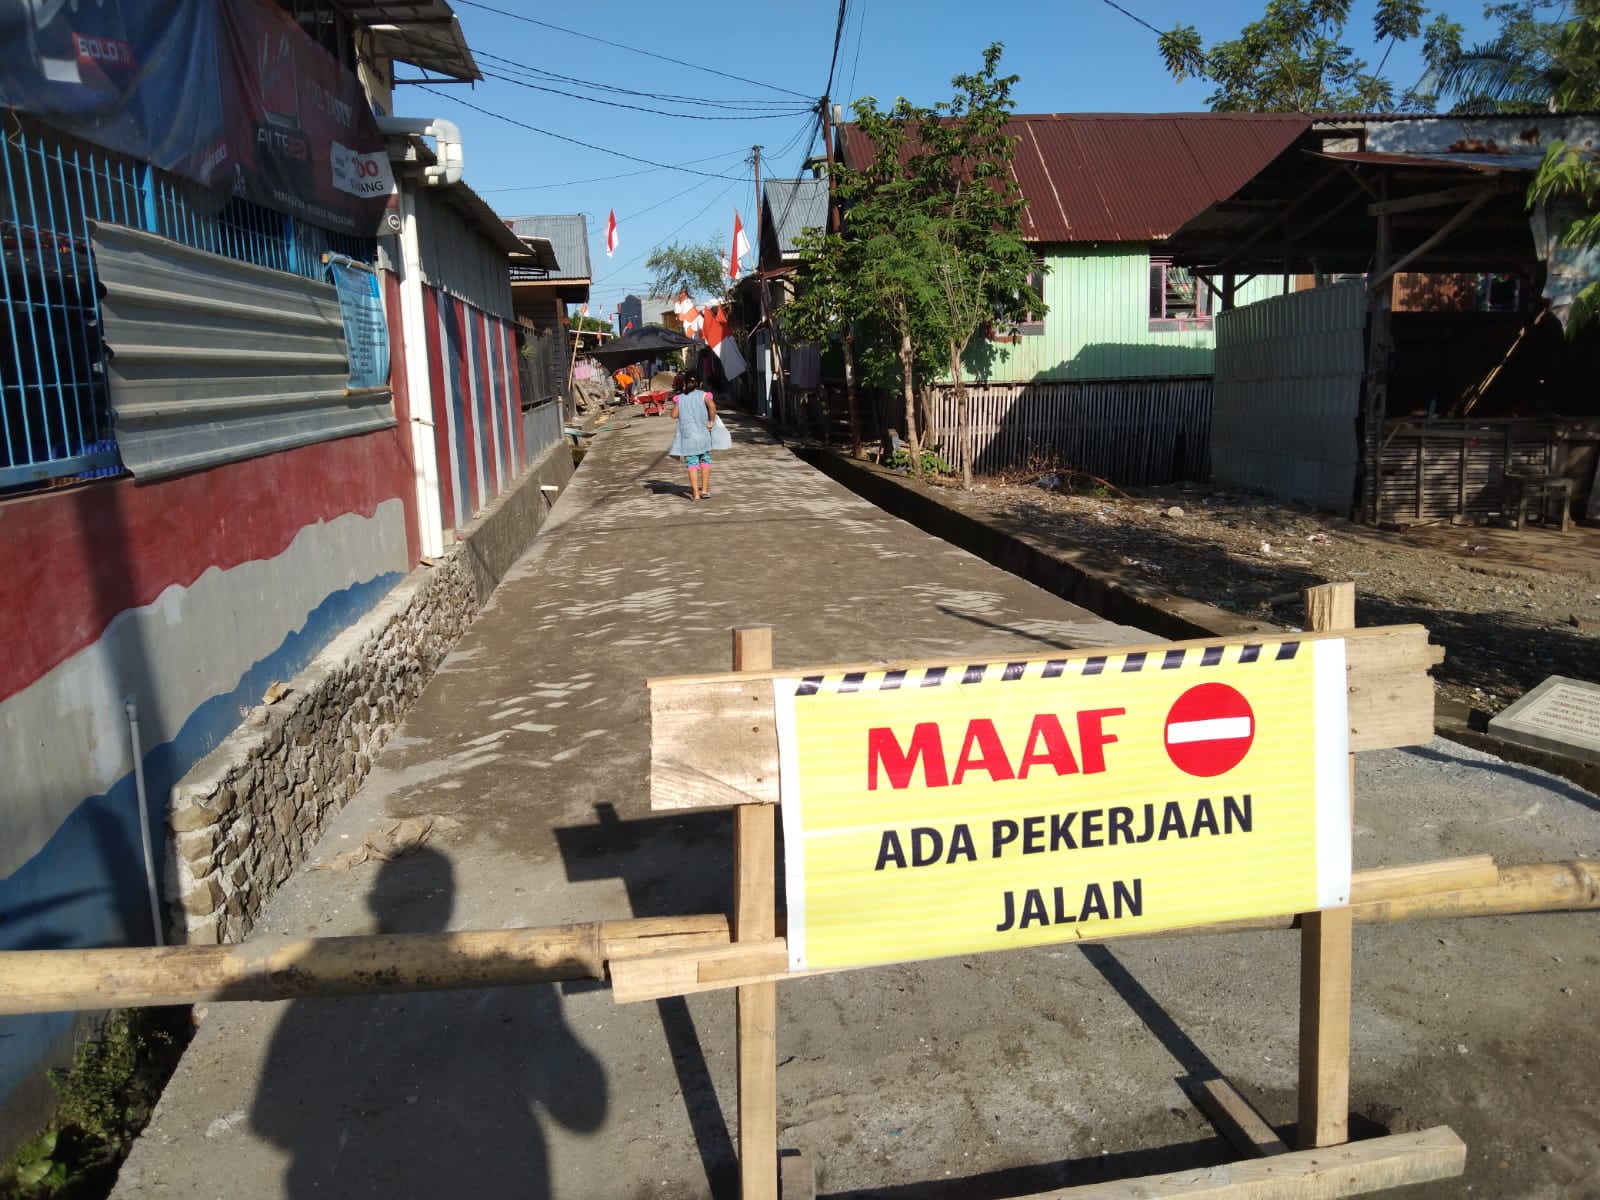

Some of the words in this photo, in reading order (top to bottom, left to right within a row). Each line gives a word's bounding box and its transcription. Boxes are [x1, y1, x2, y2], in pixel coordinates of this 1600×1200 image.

[869, 708, 1125, 790] MAAF
[876, 824, 976, 870] ADA
[993, 795, 1251, 858] PEKERJAAN
[997, 879, 1141, 931] JALAN
